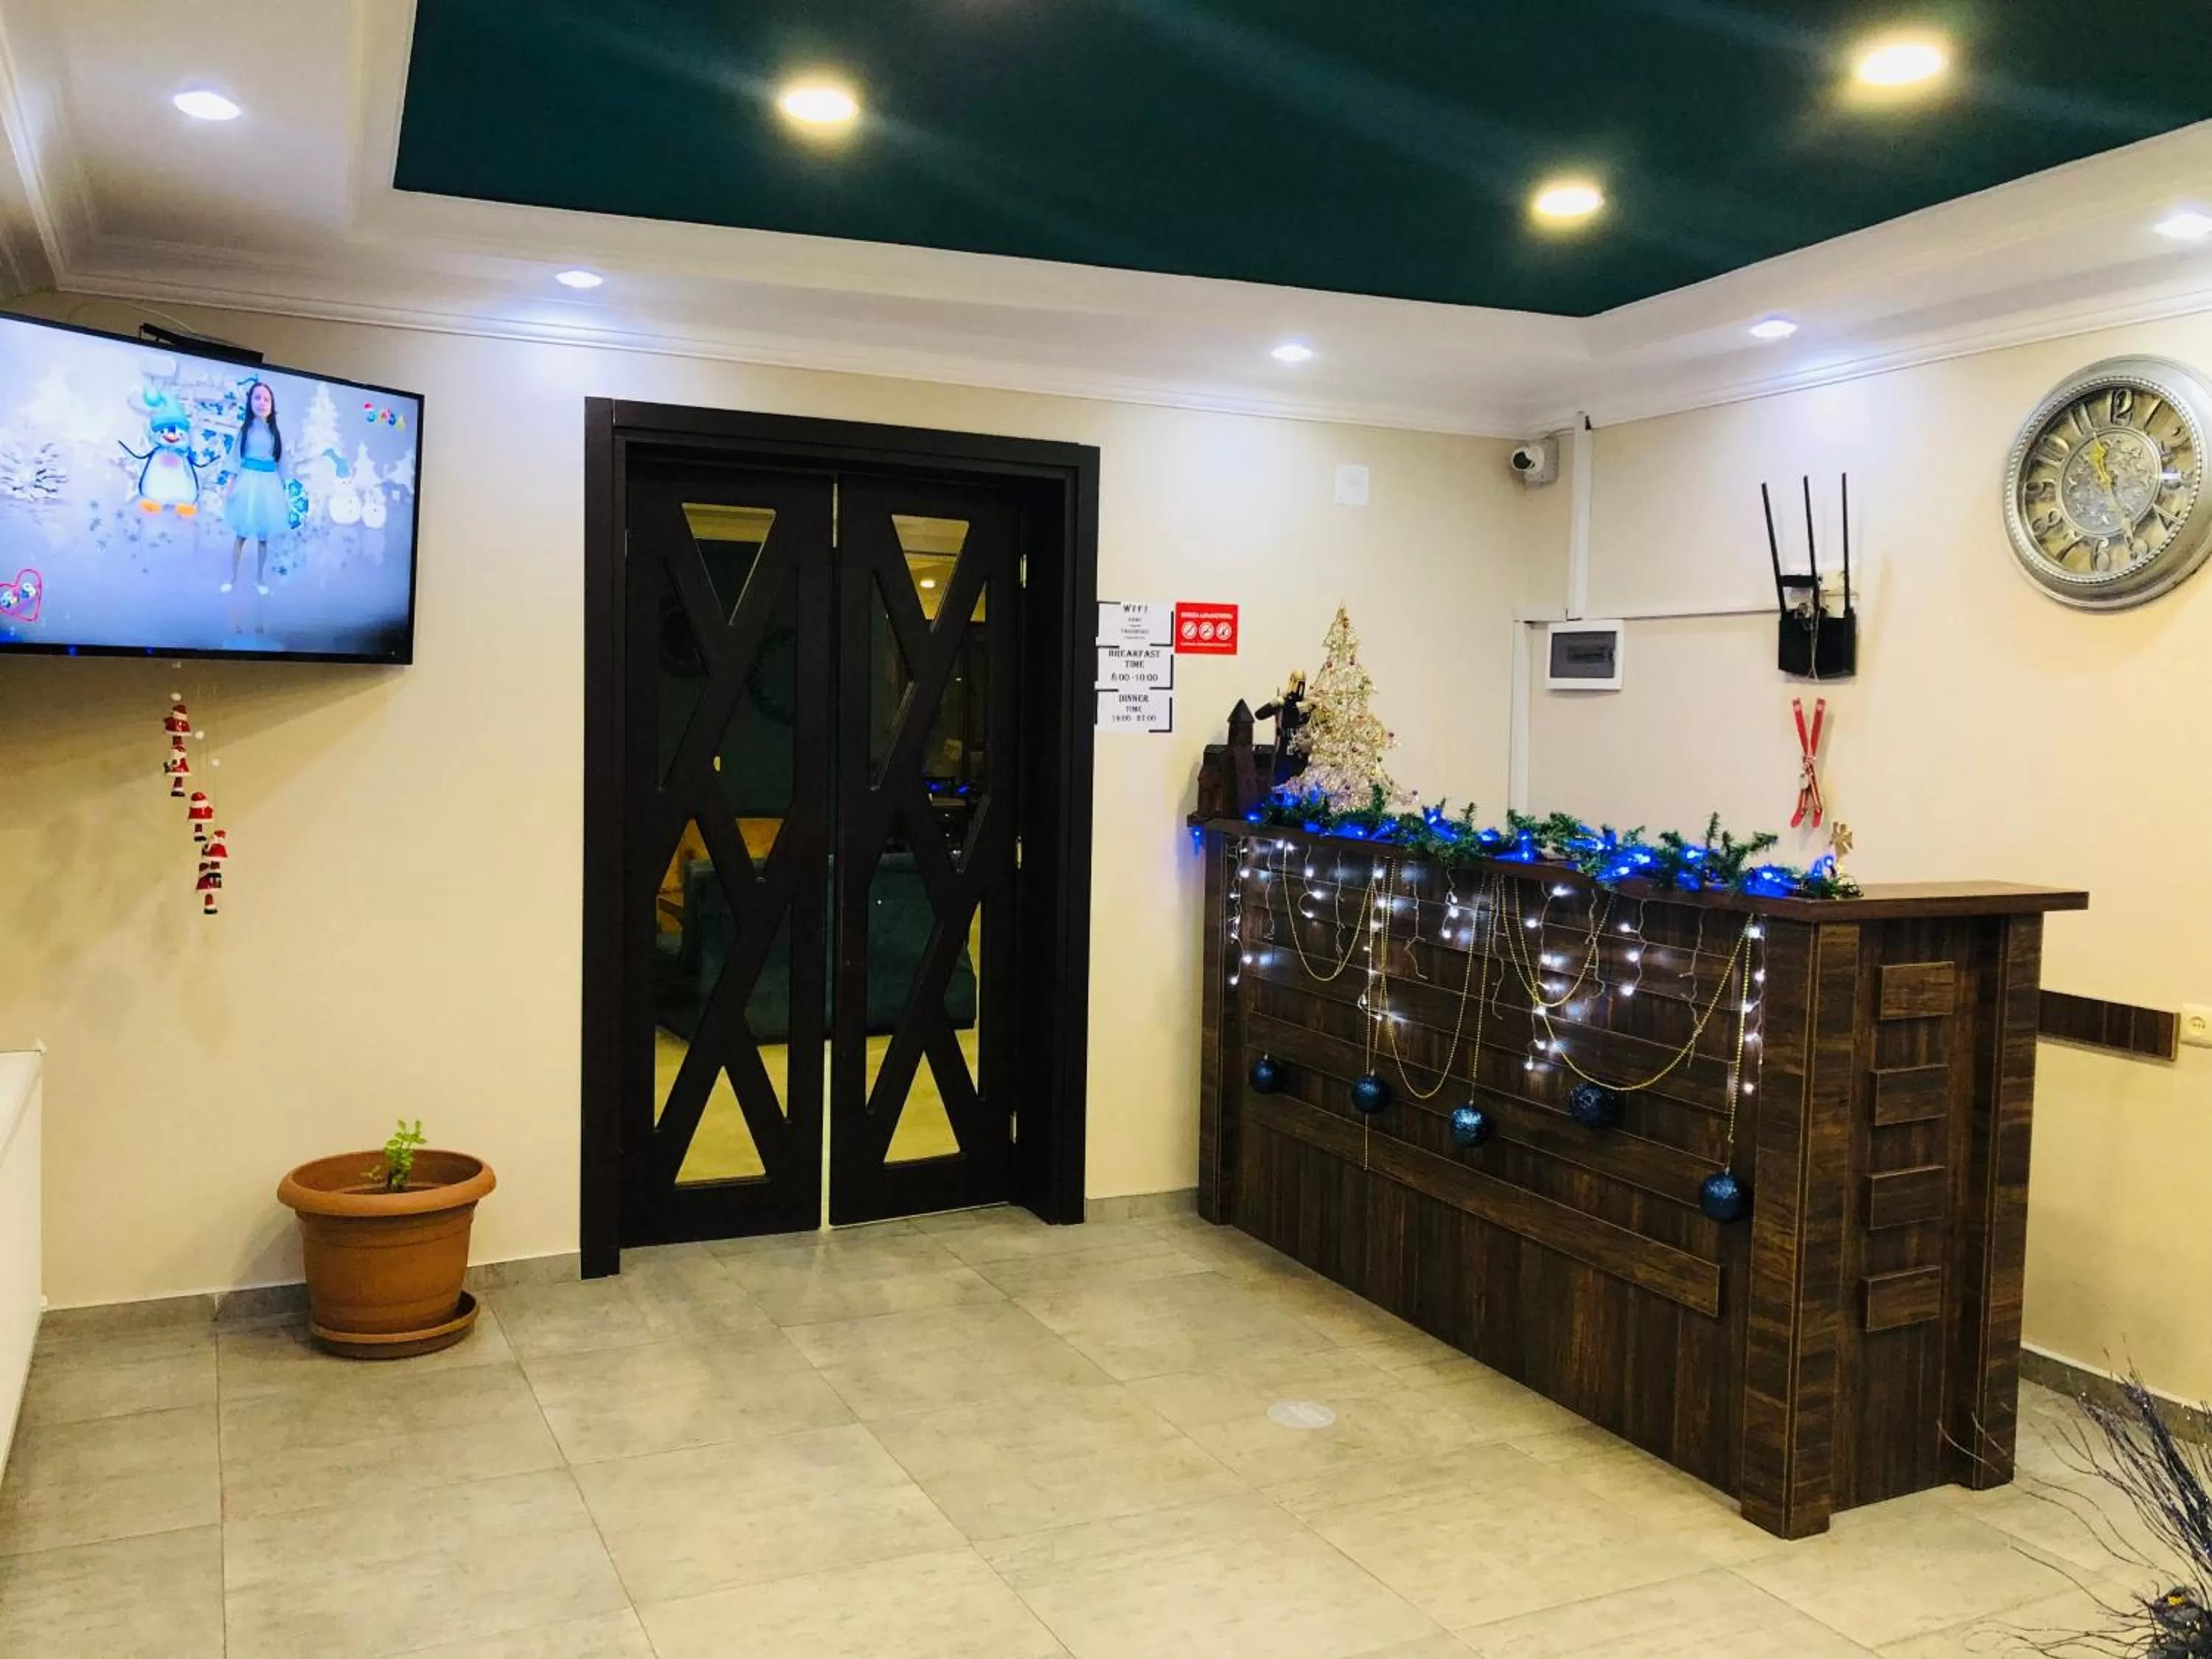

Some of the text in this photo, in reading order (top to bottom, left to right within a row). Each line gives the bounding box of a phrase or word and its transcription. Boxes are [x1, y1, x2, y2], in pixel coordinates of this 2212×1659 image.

[2107, 388, 2135, 425] 12
[1109, 650, 1161, 658] BREAKFAST
[1119, 694, 1149, 703] DINNER
